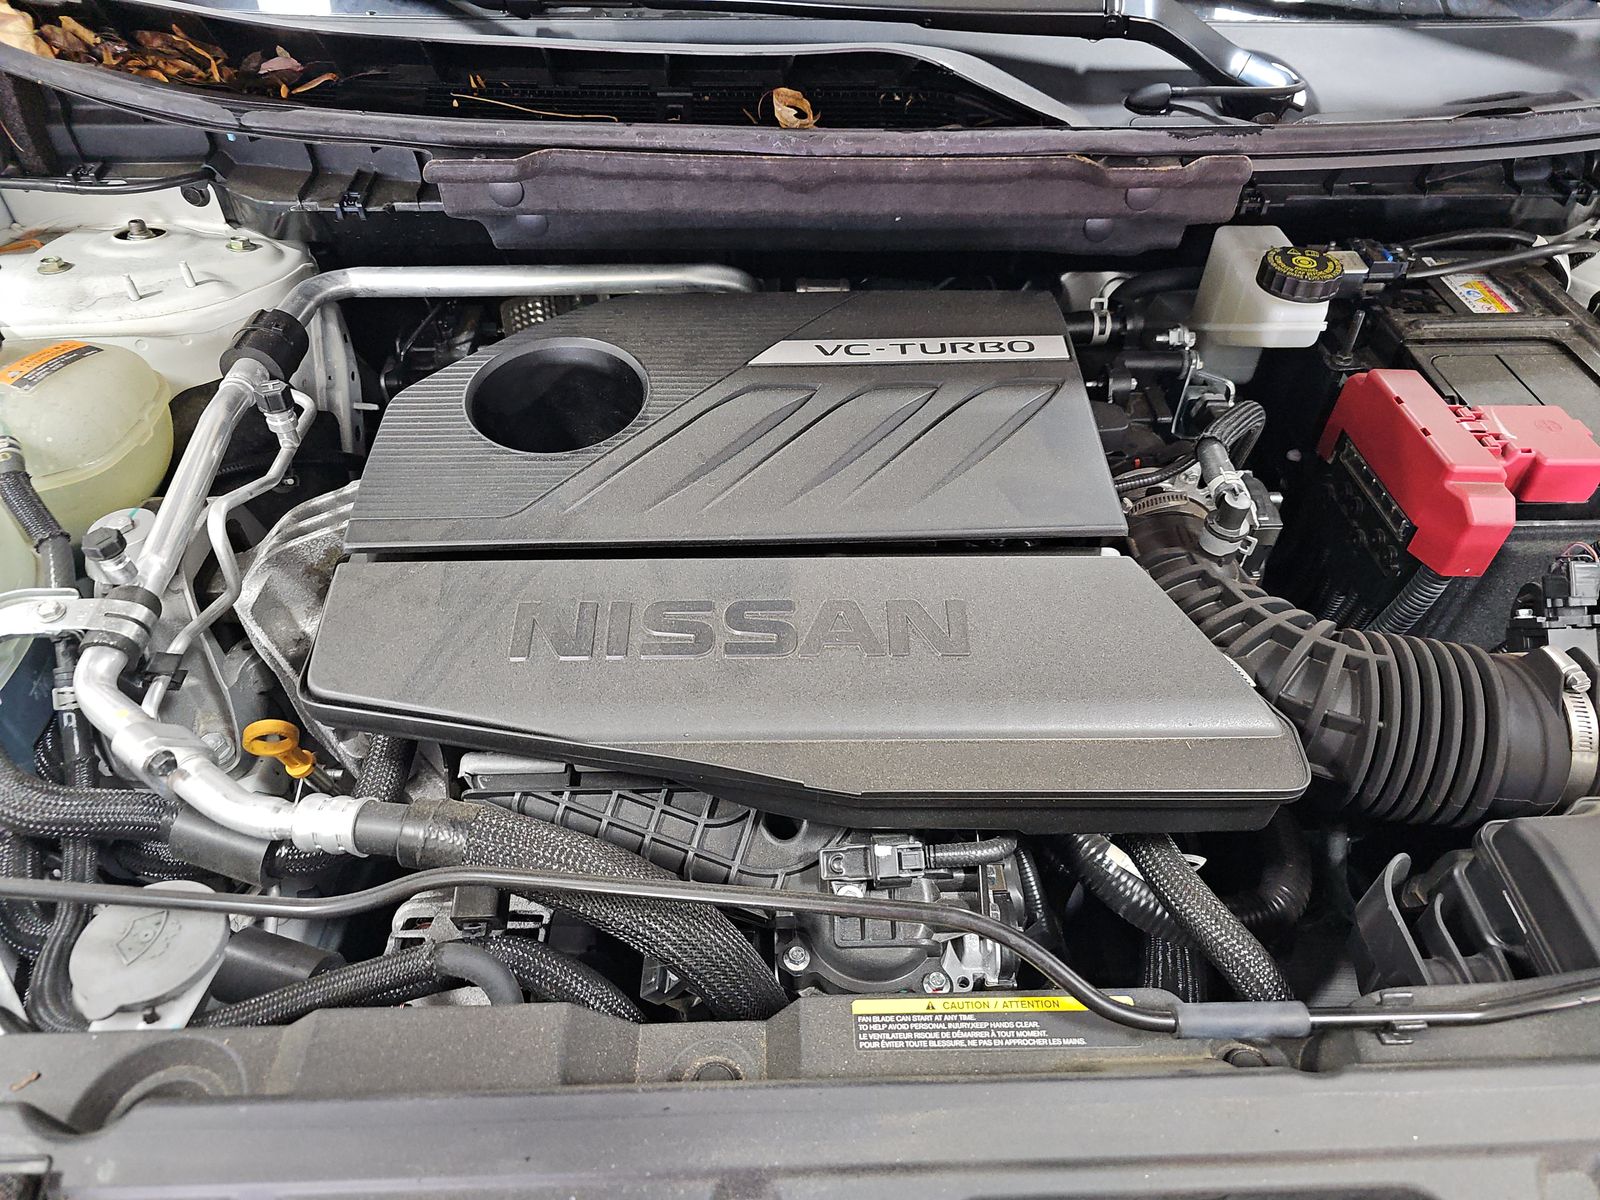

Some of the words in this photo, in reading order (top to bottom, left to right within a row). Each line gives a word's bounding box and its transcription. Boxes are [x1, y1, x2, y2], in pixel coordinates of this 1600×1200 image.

[814, 340, 1036, 357] VC-TURBO
[508, 598, 971, 662] NISSAN
[942, 1001, 990, 1010] CAUTION
[1002, 999, 1060, 1009] ATTENTION
[869, 1032, 913, 1040] VENTILATEUR
[941, 1031, 950, 1039] DE
[952, 1030, 990, 1038] DÉMARRER
[991, 1029, 997, 1037] À
[881, 1040, 905, 1048] ÉVITER
[906, 1040, 928, 1048] TOUTE
